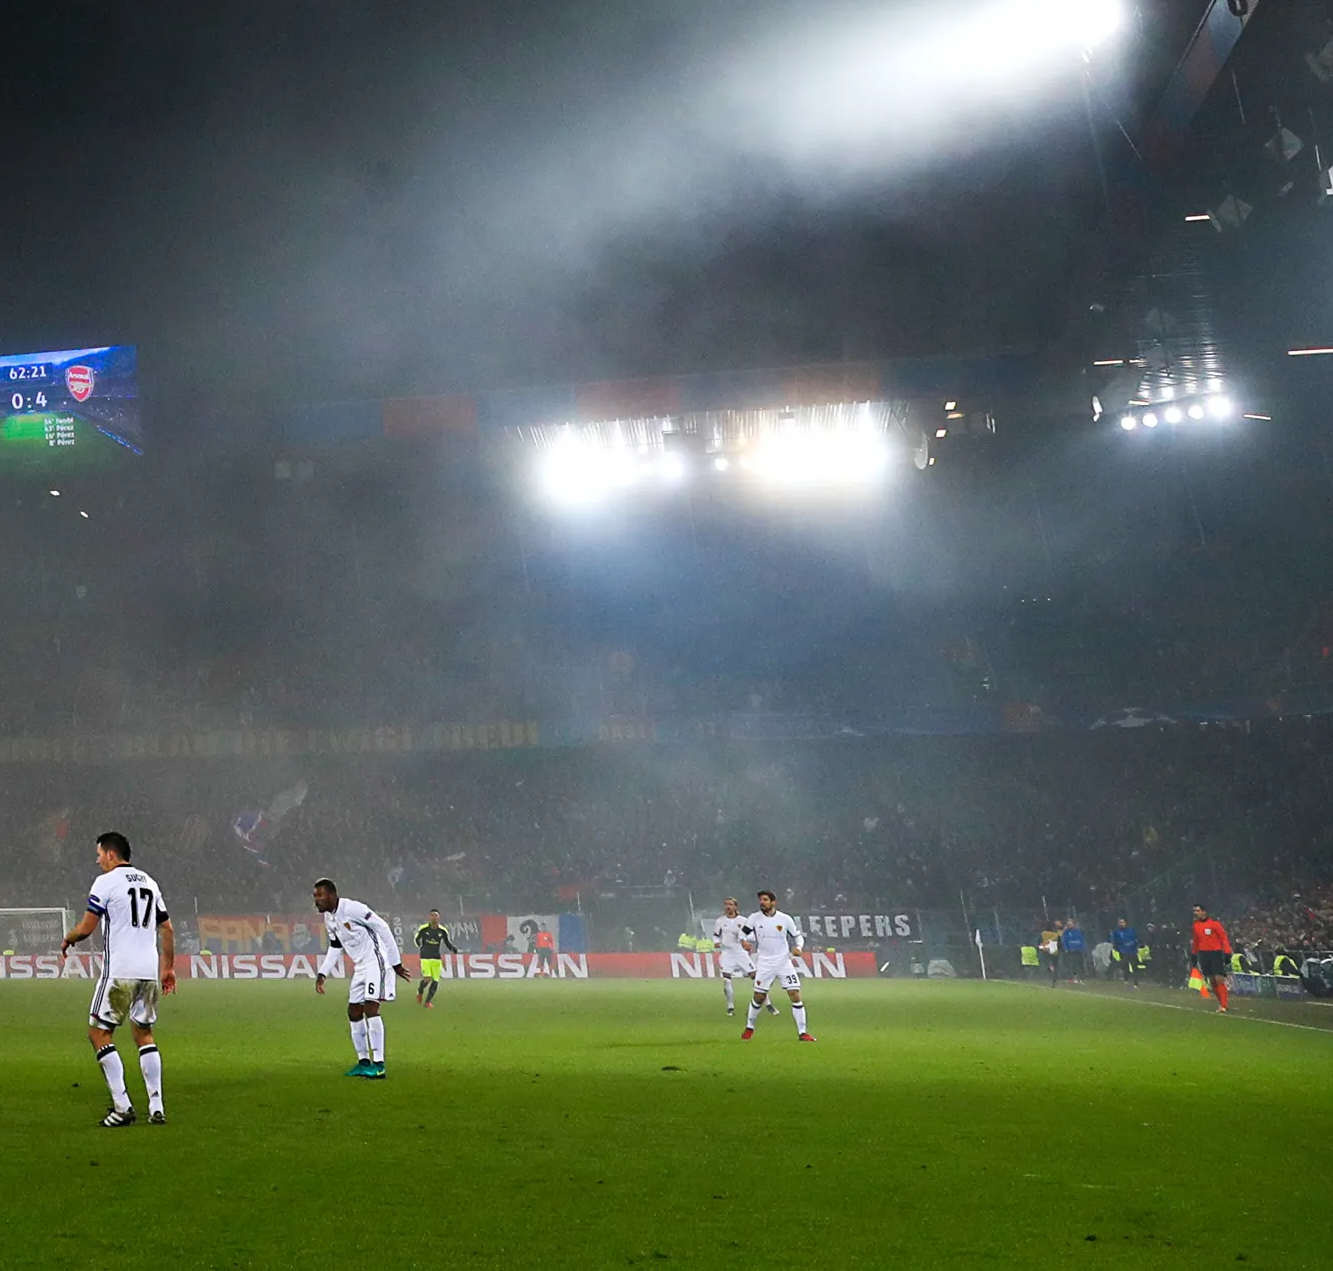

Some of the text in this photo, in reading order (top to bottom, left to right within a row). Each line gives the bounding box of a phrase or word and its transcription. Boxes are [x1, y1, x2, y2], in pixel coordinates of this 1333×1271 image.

[9, 365, 47, 380] 62:21
[127, 887, 154, 928] 17
[793, 914, 911, 939] LEEPERS
[190, 954, 346, 979] NISSAN
[441, 953, 589, 979] NISSAN
[670, 952, 847, 979] NIAN
[368, 982, 375, 996] 6
[786, 974, 798, 985] 39
